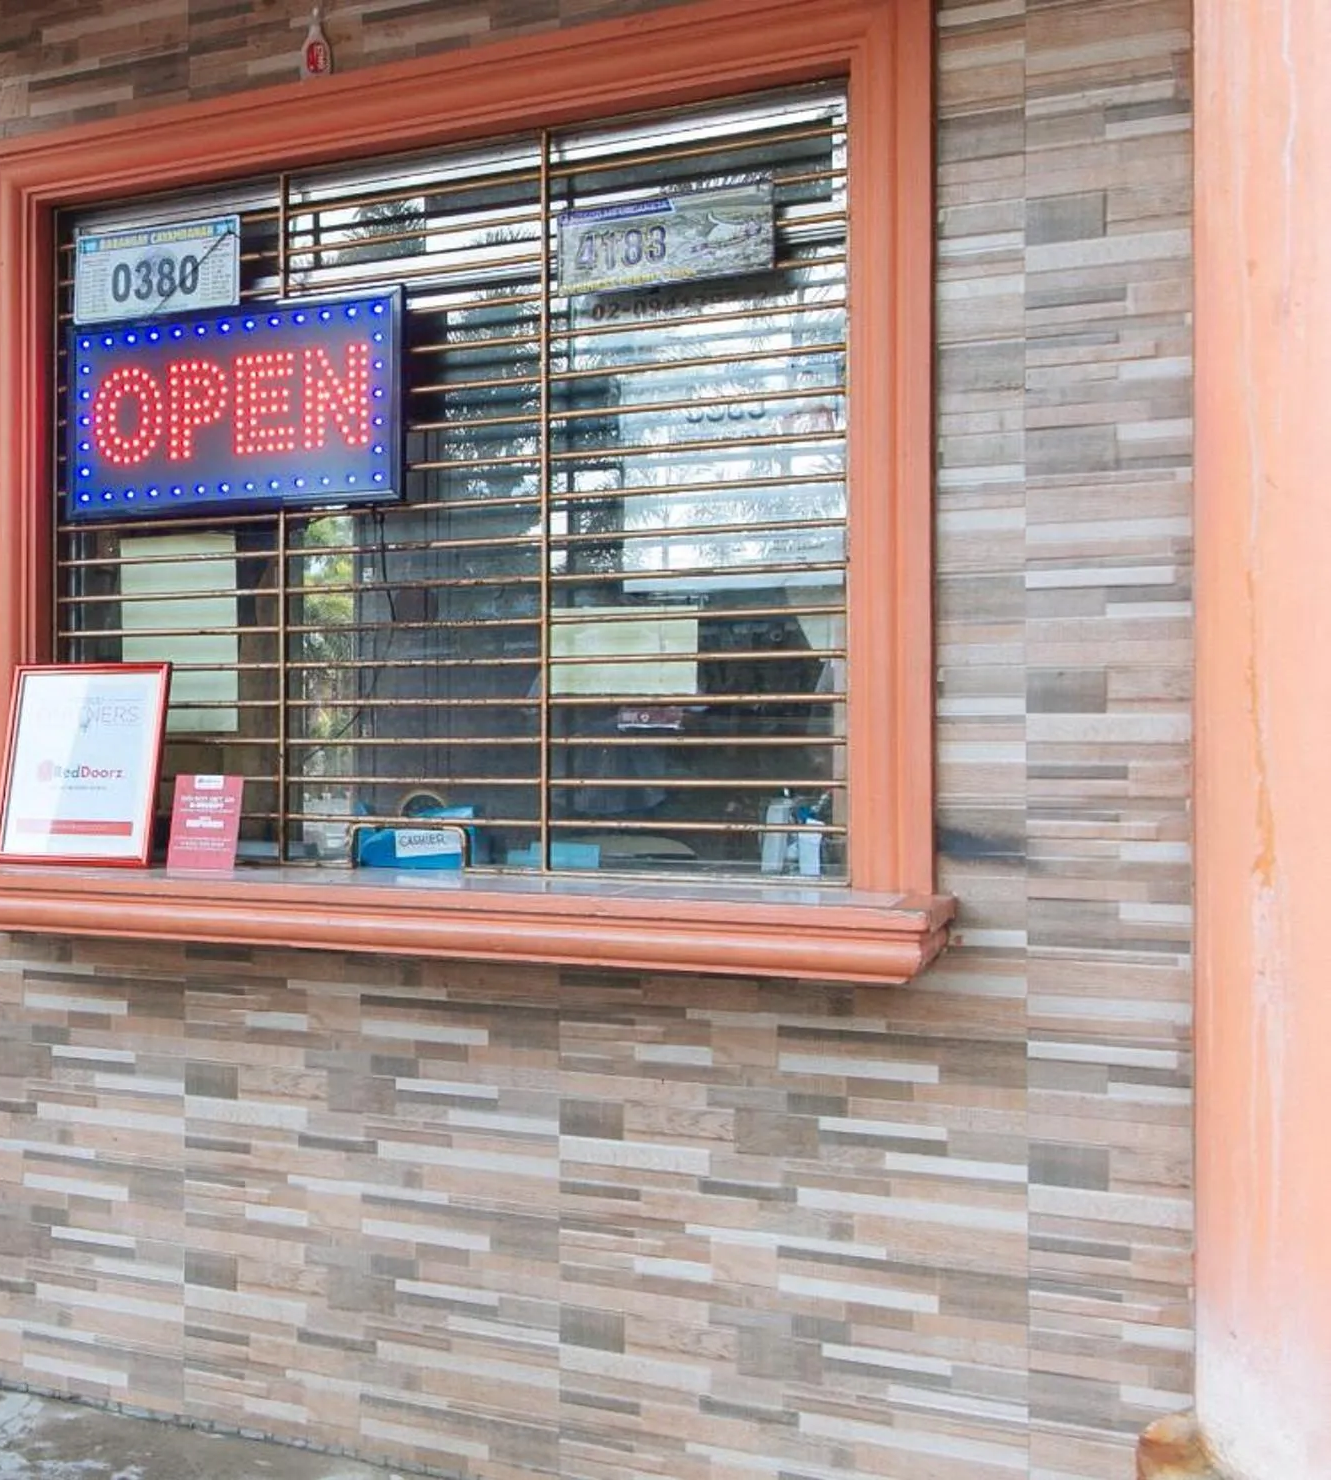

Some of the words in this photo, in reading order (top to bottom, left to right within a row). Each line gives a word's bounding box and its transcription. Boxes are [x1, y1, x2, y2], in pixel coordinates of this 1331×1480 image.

[575, 225, 667, 271] 4183
[111, 254, 200, 303] 0380
[93, 343, 371, 466] OPEN
